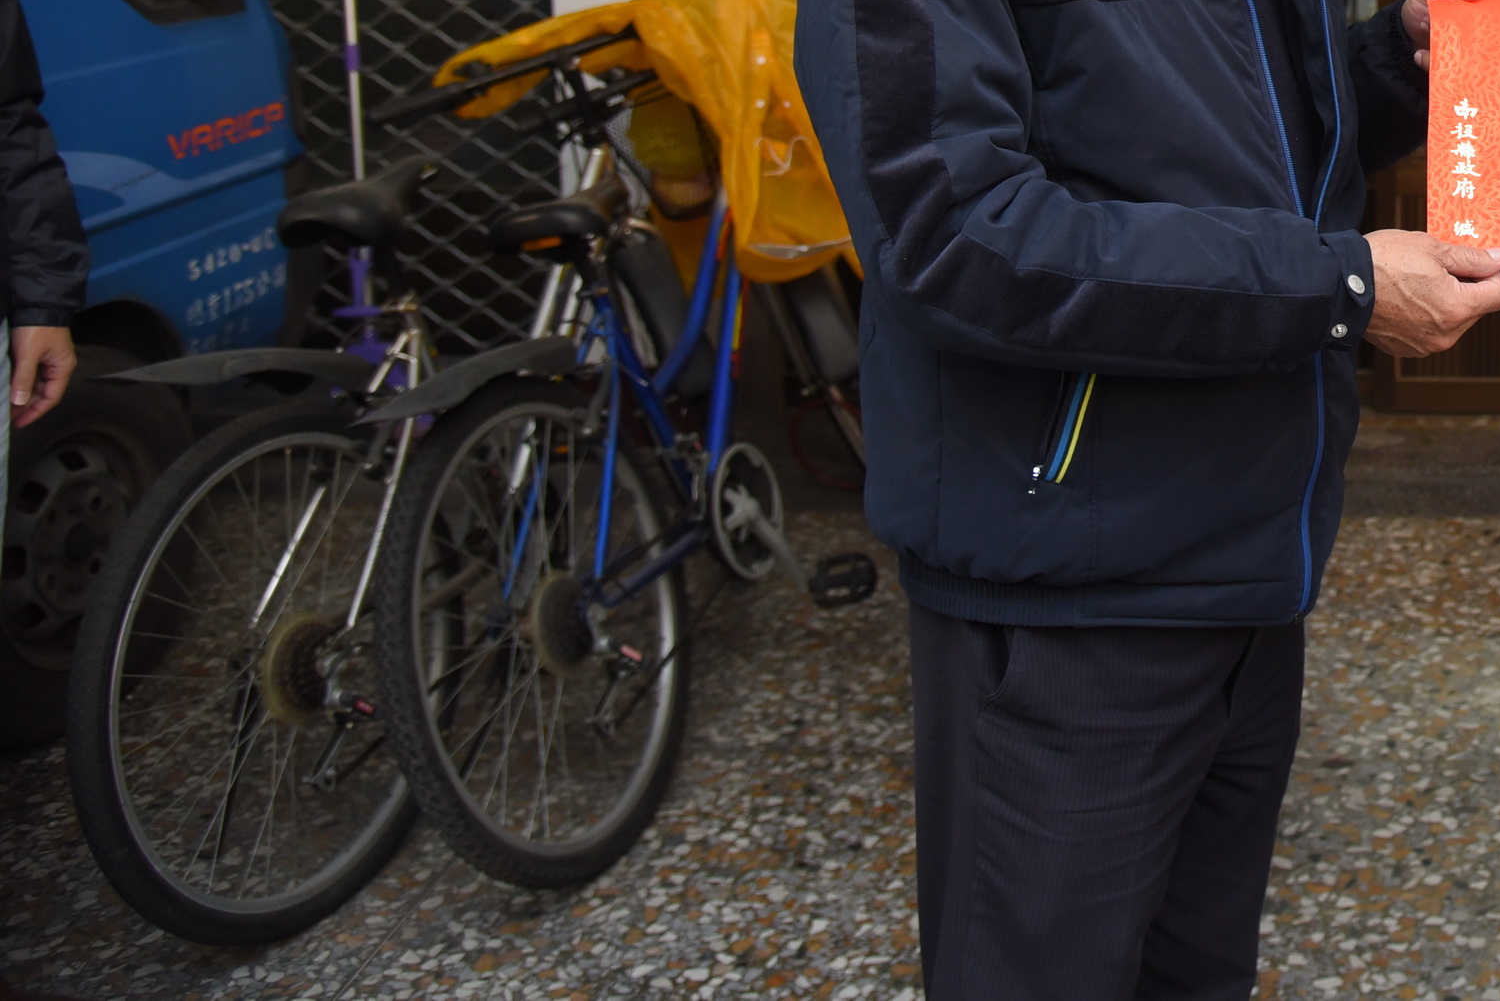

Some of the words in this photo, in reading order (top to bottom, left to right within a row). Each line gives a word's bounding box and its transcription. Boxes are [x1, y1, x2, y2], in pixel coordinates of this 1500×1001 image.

[167, 102, 286, 159] VARICA
[1450, 97, 1482, 200] 南投縣政府
